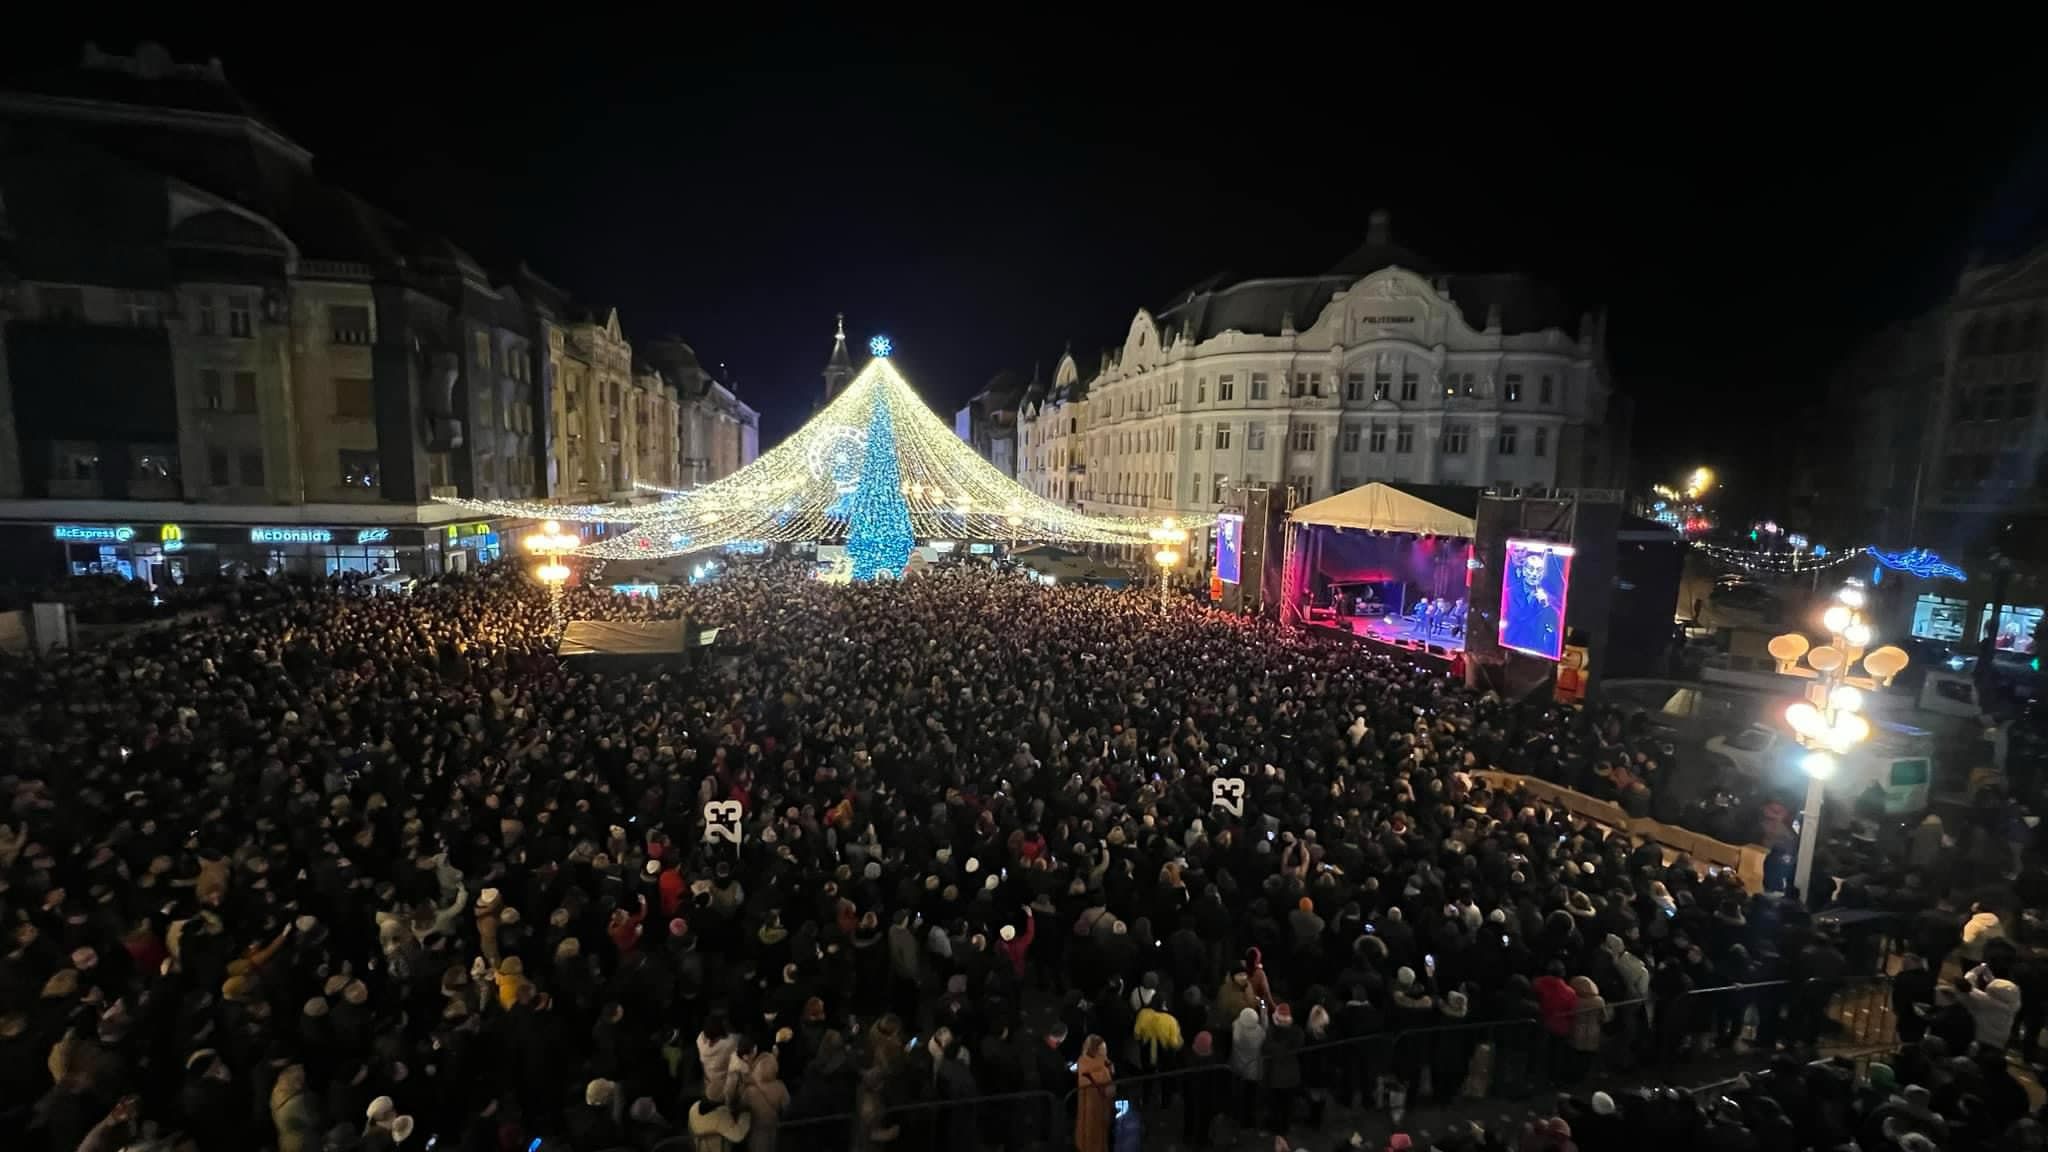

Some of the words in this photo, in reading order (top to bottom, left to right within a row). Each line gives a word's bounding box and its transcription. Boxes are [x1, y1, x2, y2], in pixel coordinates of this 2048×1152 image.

[251, 528, 331, 542] McDonald's
[1212, 778, 1244, 816] 23
[704, 800, 742, 843] 23
